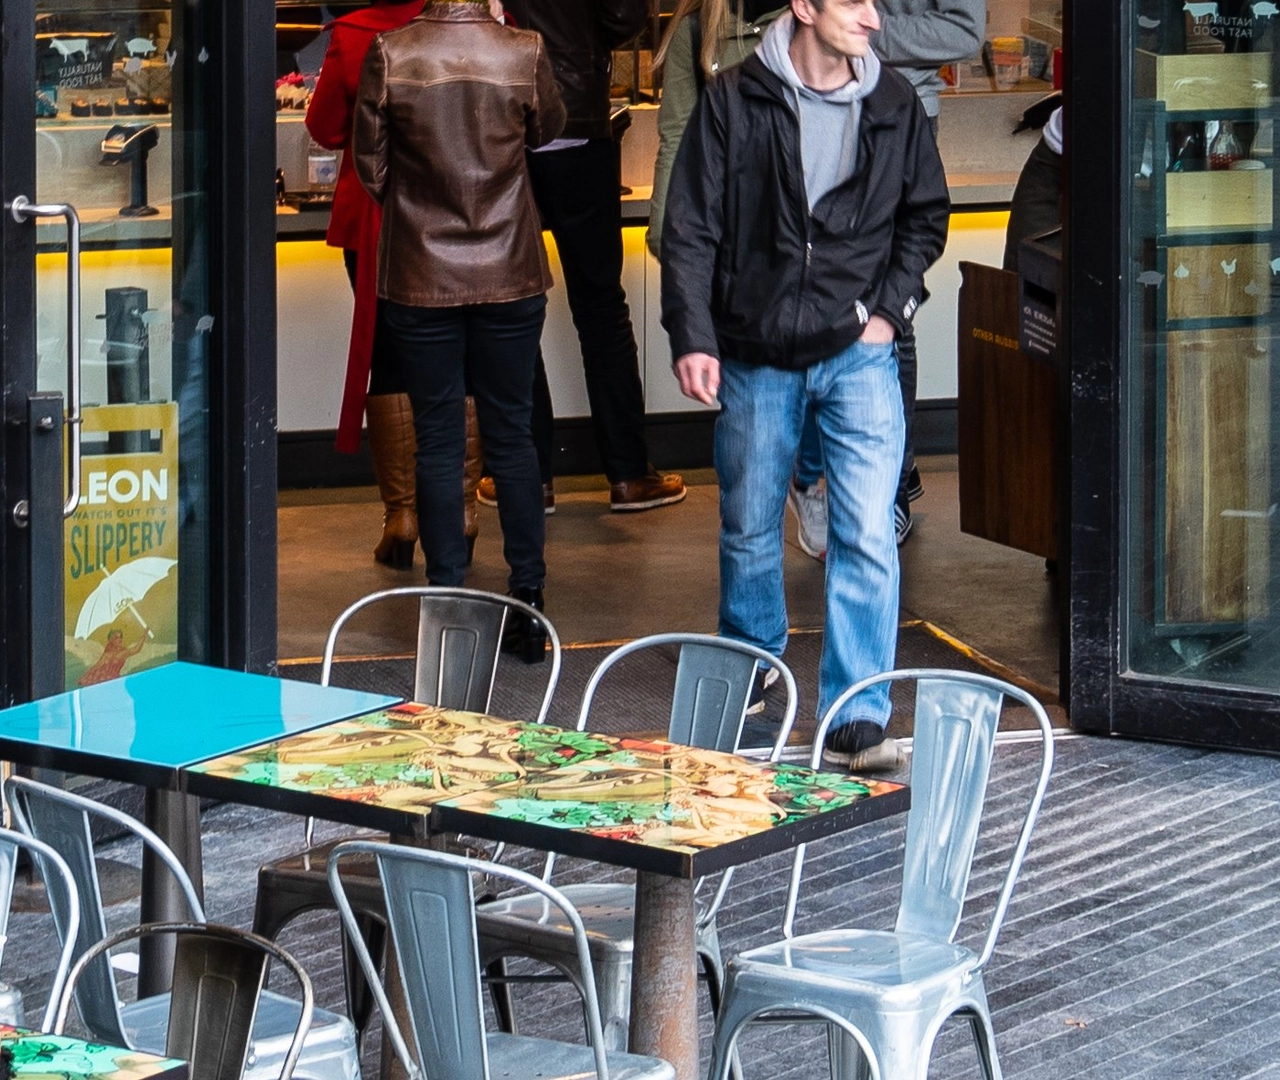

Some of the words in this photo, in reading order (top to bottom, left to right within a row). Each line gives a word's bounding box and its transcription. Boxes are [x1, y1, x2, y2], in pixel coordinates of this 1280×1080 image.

[72, 509, 113, 521] WATCH
[116, 507, 141, 519] OUT
[70, 520, 167, 580] SLIPPERY
